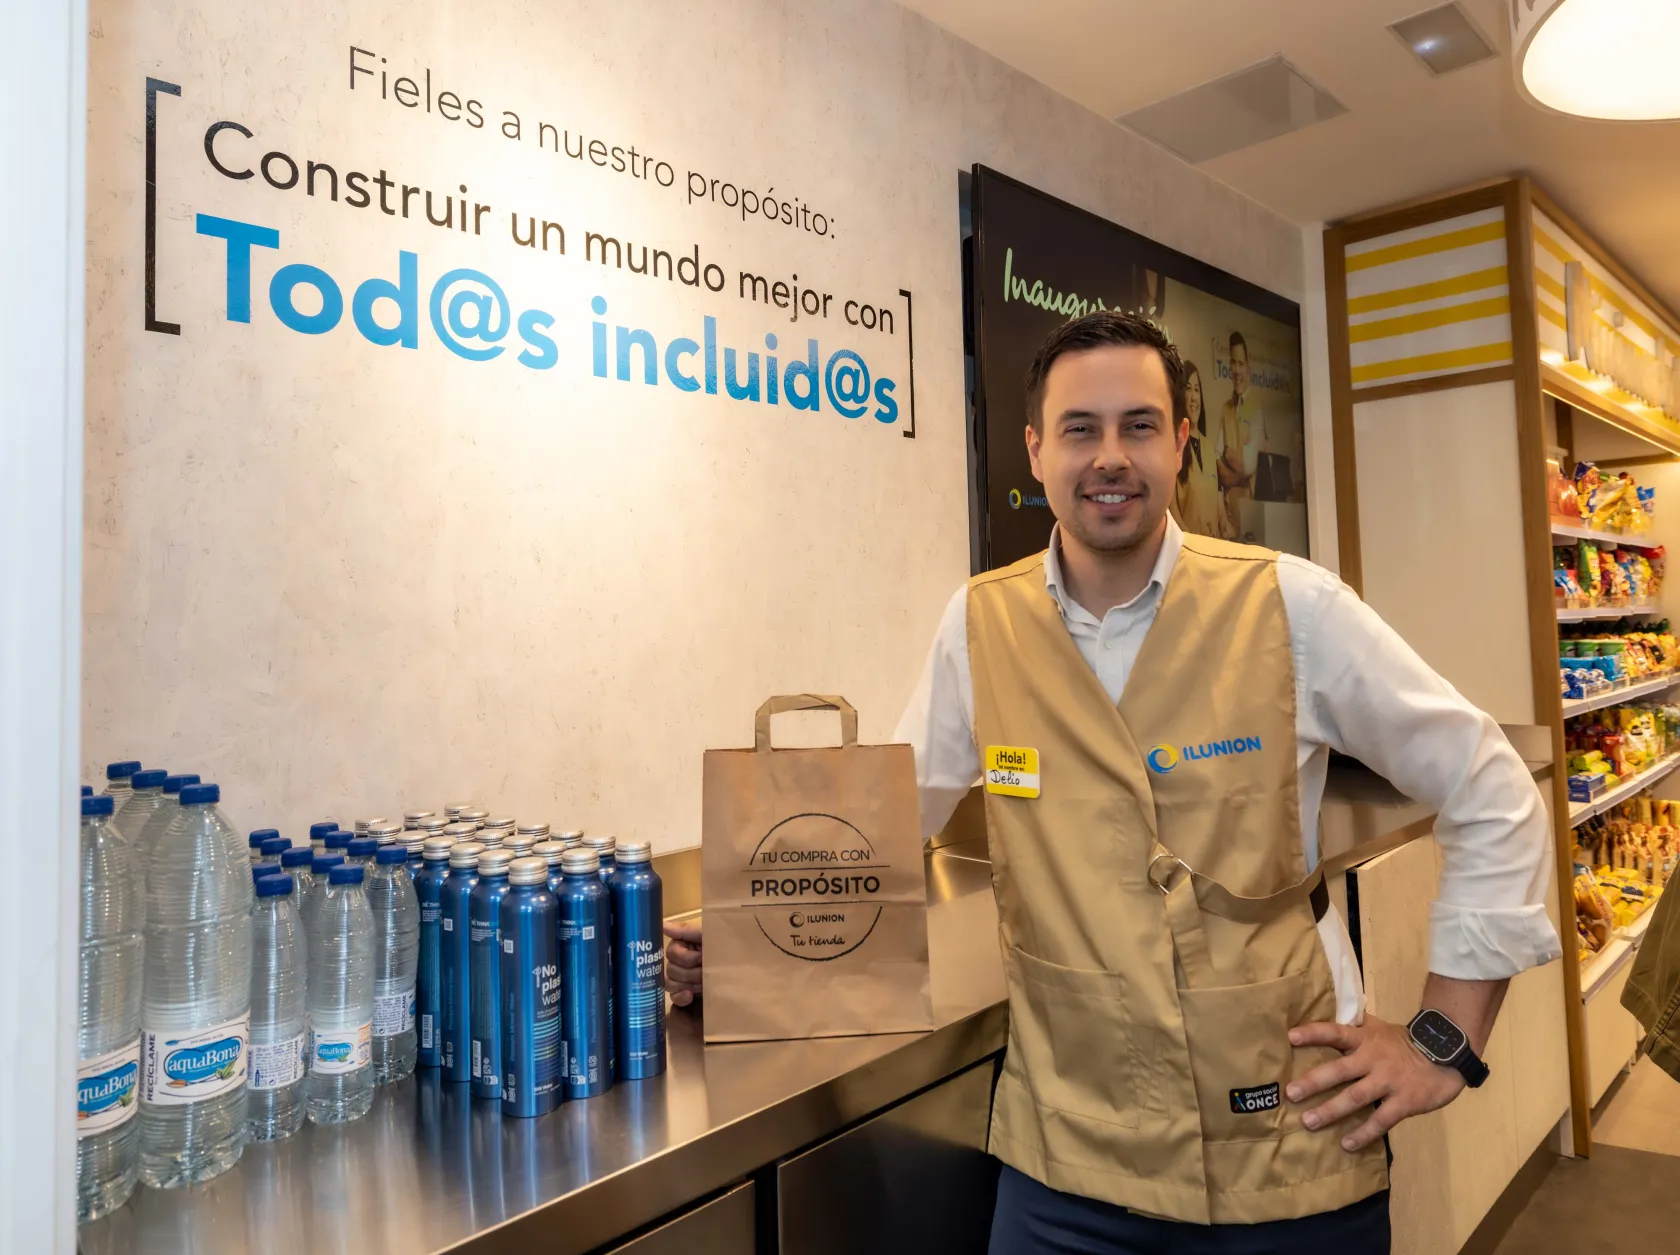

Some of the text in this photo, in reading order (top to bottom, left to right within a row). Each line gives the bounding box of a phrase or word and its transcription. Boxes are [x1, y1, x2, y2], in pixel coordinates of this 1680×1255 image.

[349, 45, 836, 239] Fieles a nuestro propósito:
[203, 120, 895, 335] Construir un mundo mejor con
[196, 212, 899, 424] Tod@s incluid@s
[1182, 735, 1263, 761] ILUNION
[996, 750, 1026, 766] ¡Hola!
[760, 849, 870, 864] TU COMPRA CON
[751, 872, 881, 897] PROPÓSITO
[807, 914, 845, 924] ILUNION
[636, 940, 653, 952] No
[790, 934, 846, 947] Tu tienda
[636, 947, 665, 968] plasti
[542, 965, 556, 978] No
[636, 963, 662, 978] water
[542, 975, 561, 996] plas
[168, 1045, 240, 1074] aquaBona
[78, 1070, 137, 1105] quaBon
[1245, 1090, 1262, 1099] grupo
[1246, 1093, 1279, 1110] ONCE
